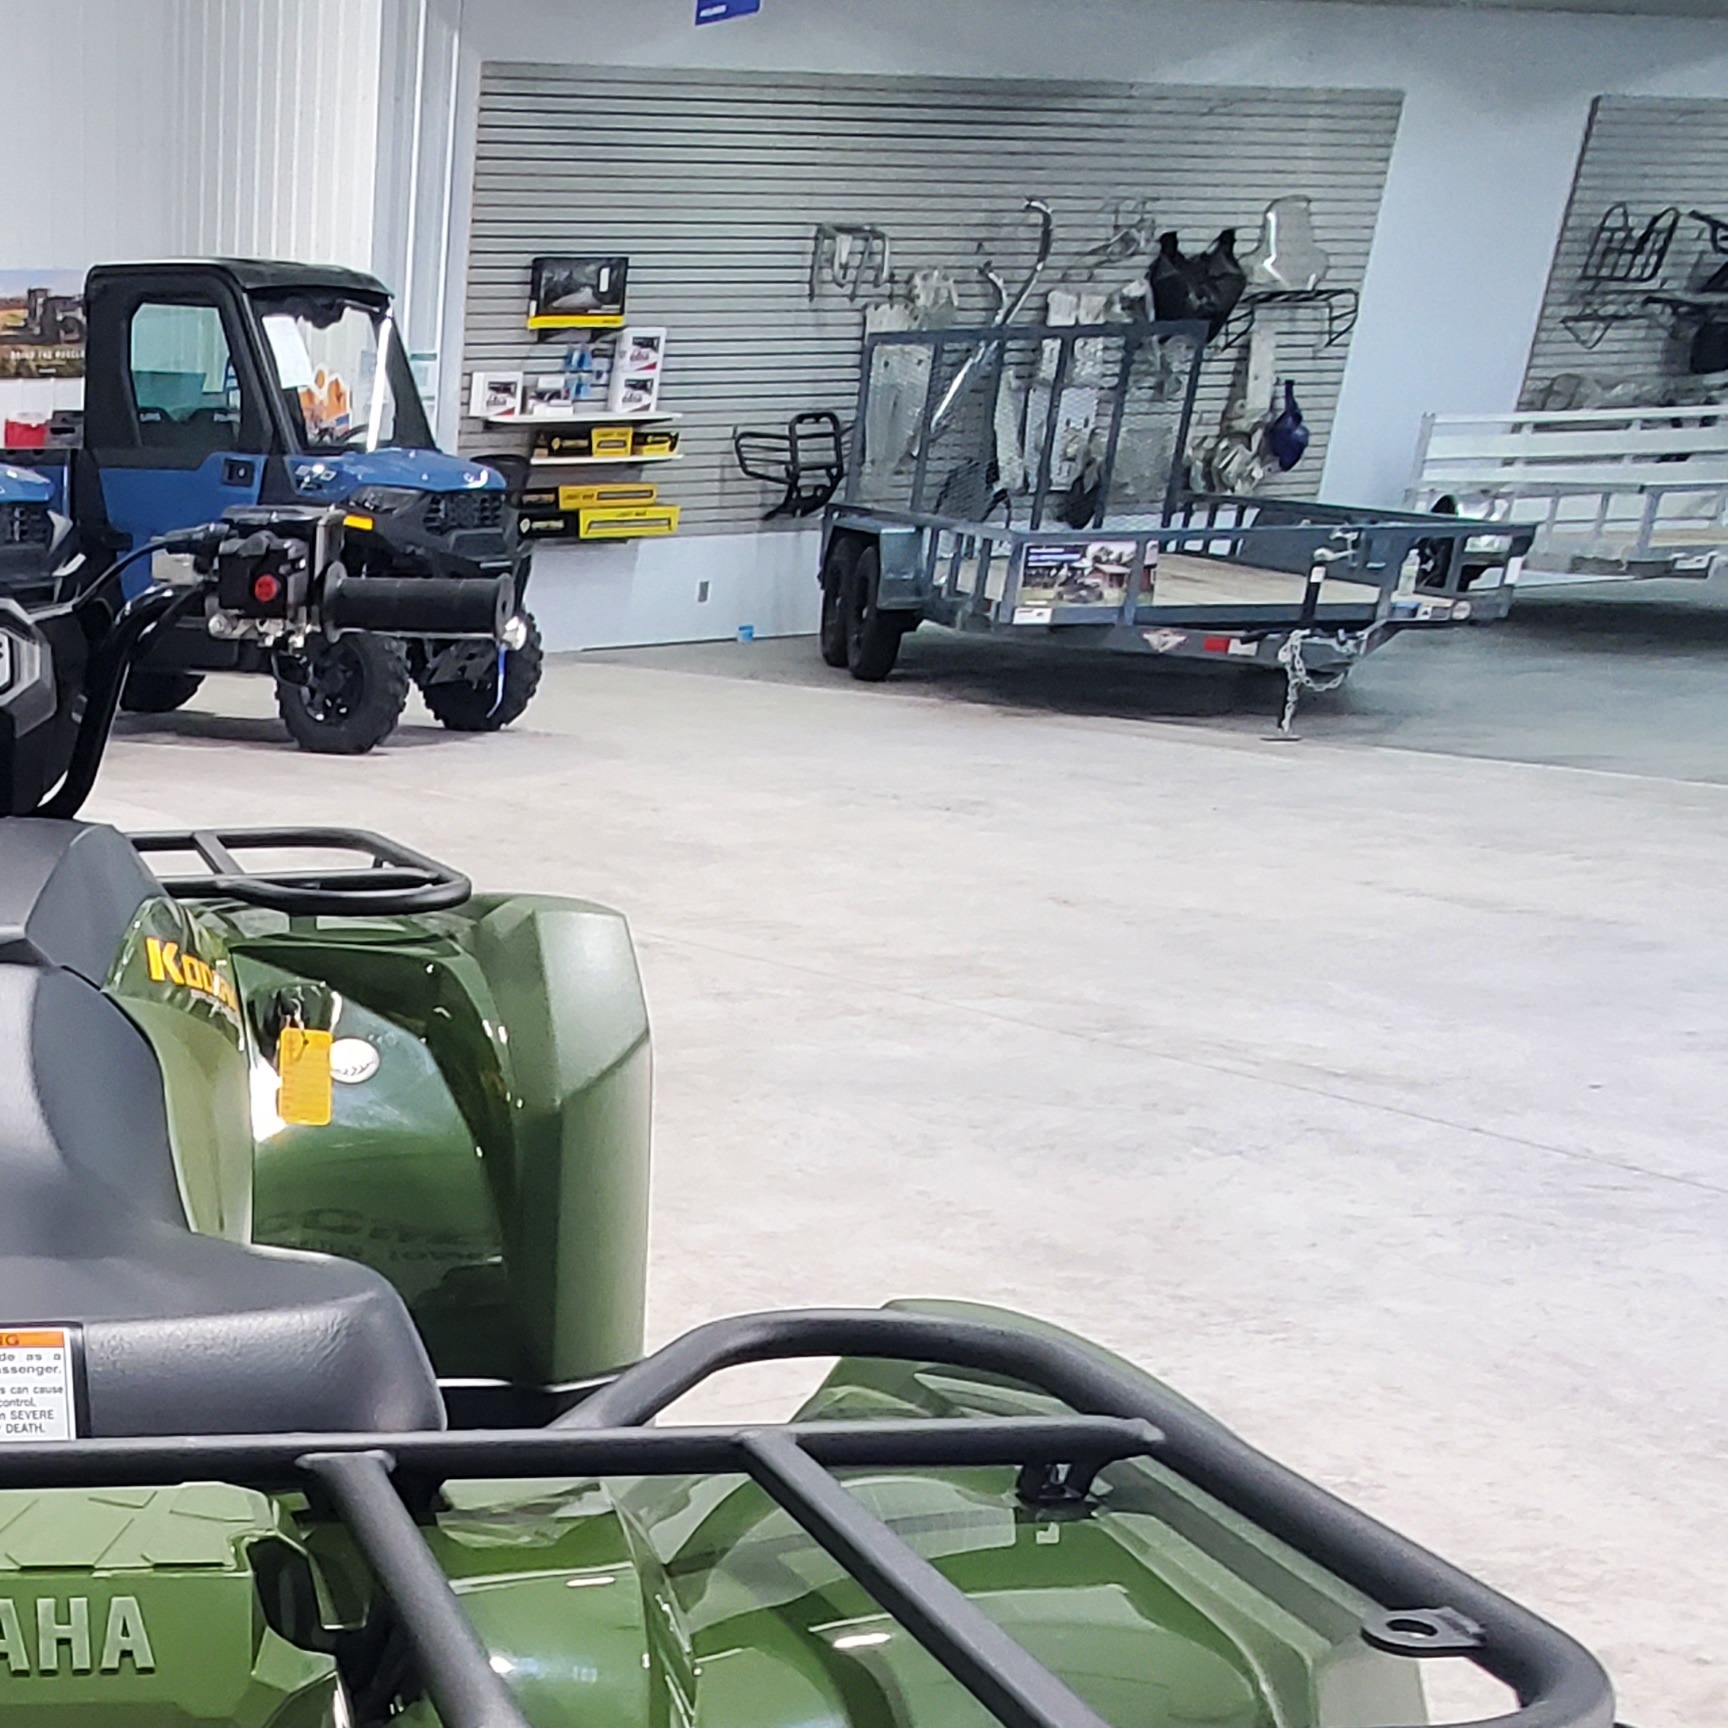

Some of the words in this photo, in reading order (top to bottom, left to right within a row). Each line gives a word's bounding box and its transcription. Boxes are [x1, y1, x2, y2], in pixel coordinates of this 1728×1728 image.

[26, 1353, 43, 1361] as
[53, 1353, 62, 1361] a
[10, 1386, 29, 1394] can
[33, 1386, 63, 1394] cause
[10, 1409, 54, 1420] SEVERE
[6, 1423, 46, 1434] DEATH.
